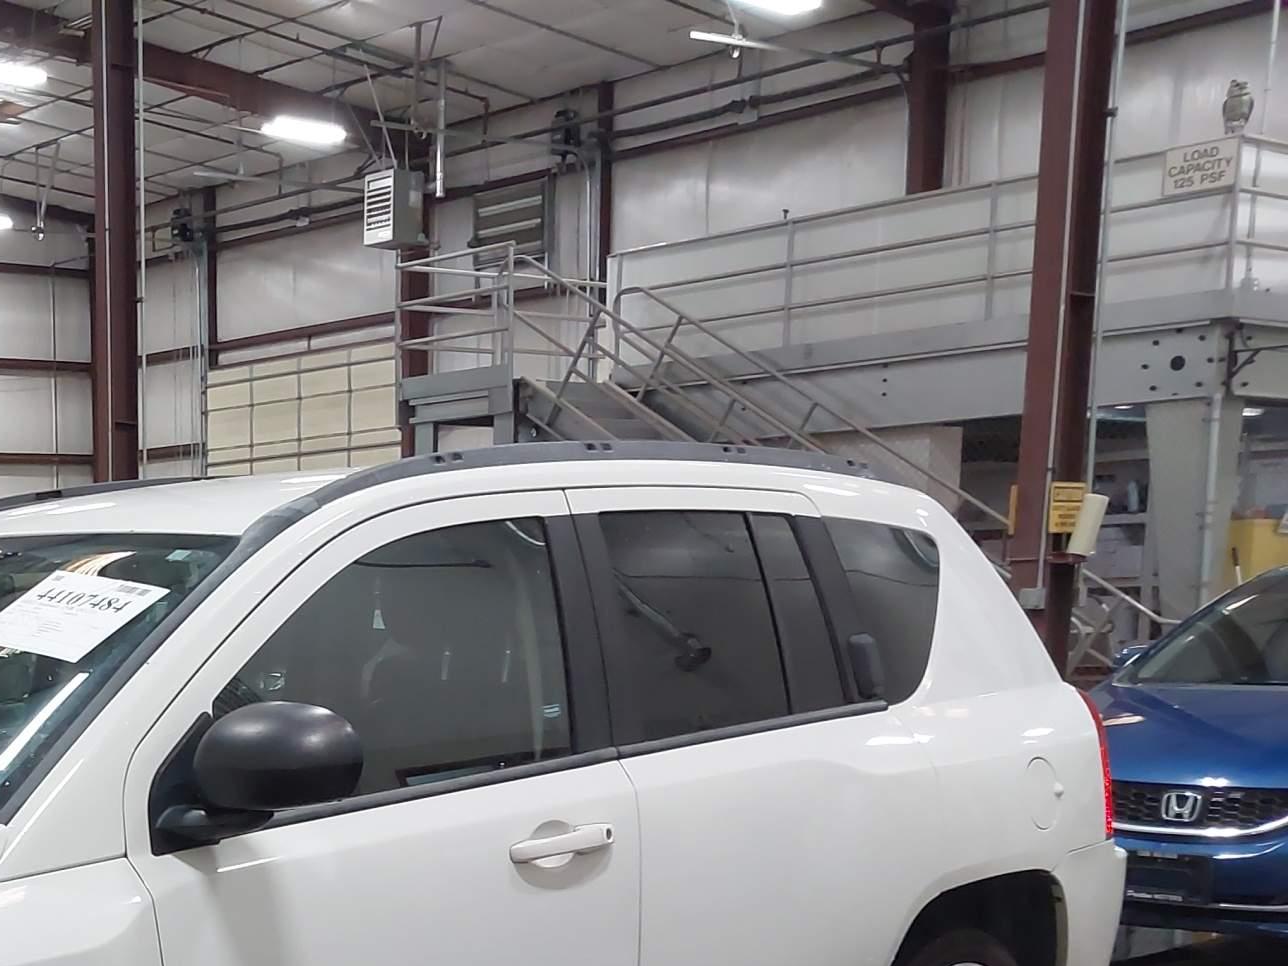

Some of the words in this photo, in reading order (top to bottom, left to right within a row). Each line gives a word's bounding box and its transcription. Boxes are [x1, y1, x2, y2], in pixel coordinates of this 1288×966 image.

[1183, 146, 1220, 163] LOAD
[1168, 157, 1233, 178] CAPACITY
[1173, 175, 1194, 190] 125
[1200, 170, 1226, 185] PSF
